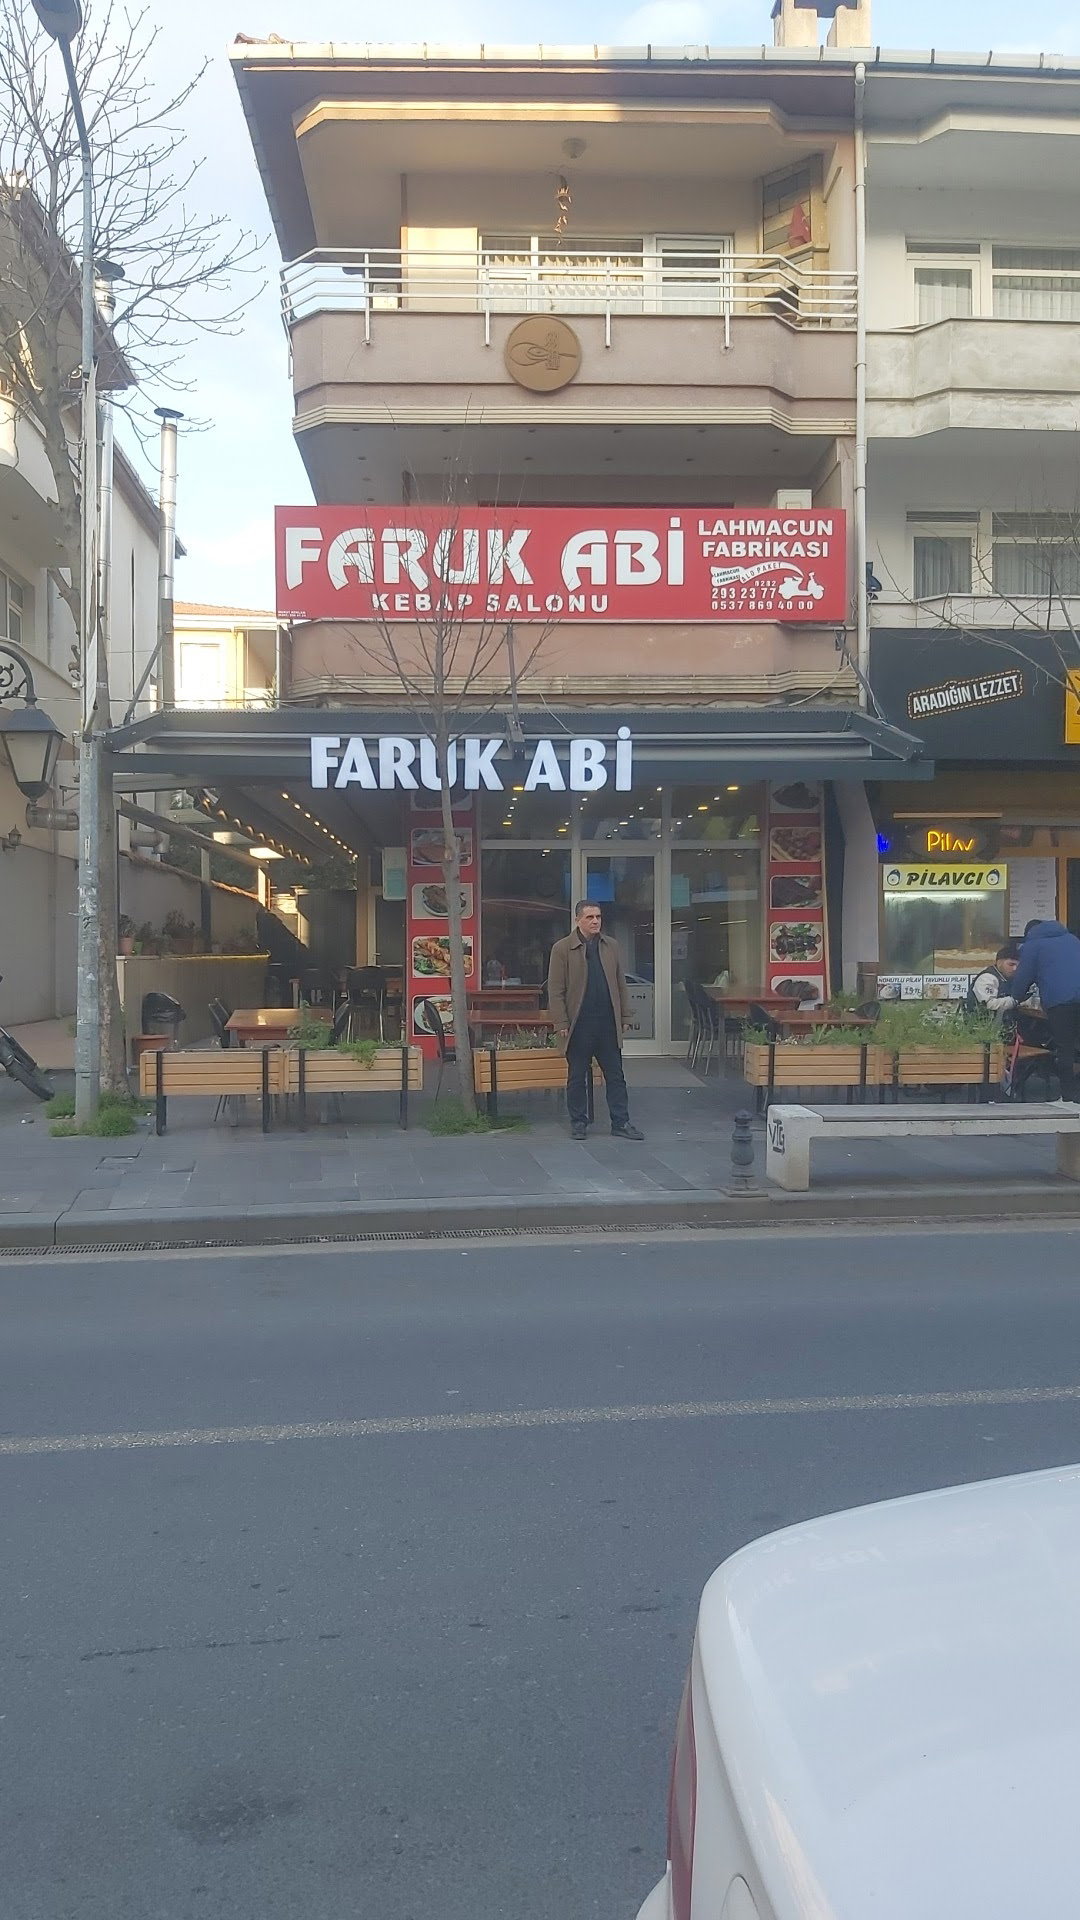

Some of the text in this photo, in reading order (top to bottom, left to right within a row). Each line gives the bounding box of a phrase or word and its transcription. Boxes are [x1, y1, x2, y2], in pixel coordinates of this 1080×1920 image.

[698, 519, 833, 536] LAHMACUN
[286, 517, 684, 592] FARUK ABİ
[702, 537, 829, 558] FABRİKASI
[756, 562, 781, 573] PAKET
[711, 587, 777, 599] 293 23 77
[372, 593, 609, 612] KEBAP SALONU
[711, 600, 814, 610] 0537 869 40 00
[912, 675, 1018, 714] ARADIĞIN LEZZET
[310, 726, 633, 792] FARUK ABİ
[906, 869, 984, 886] PİLAVCI
